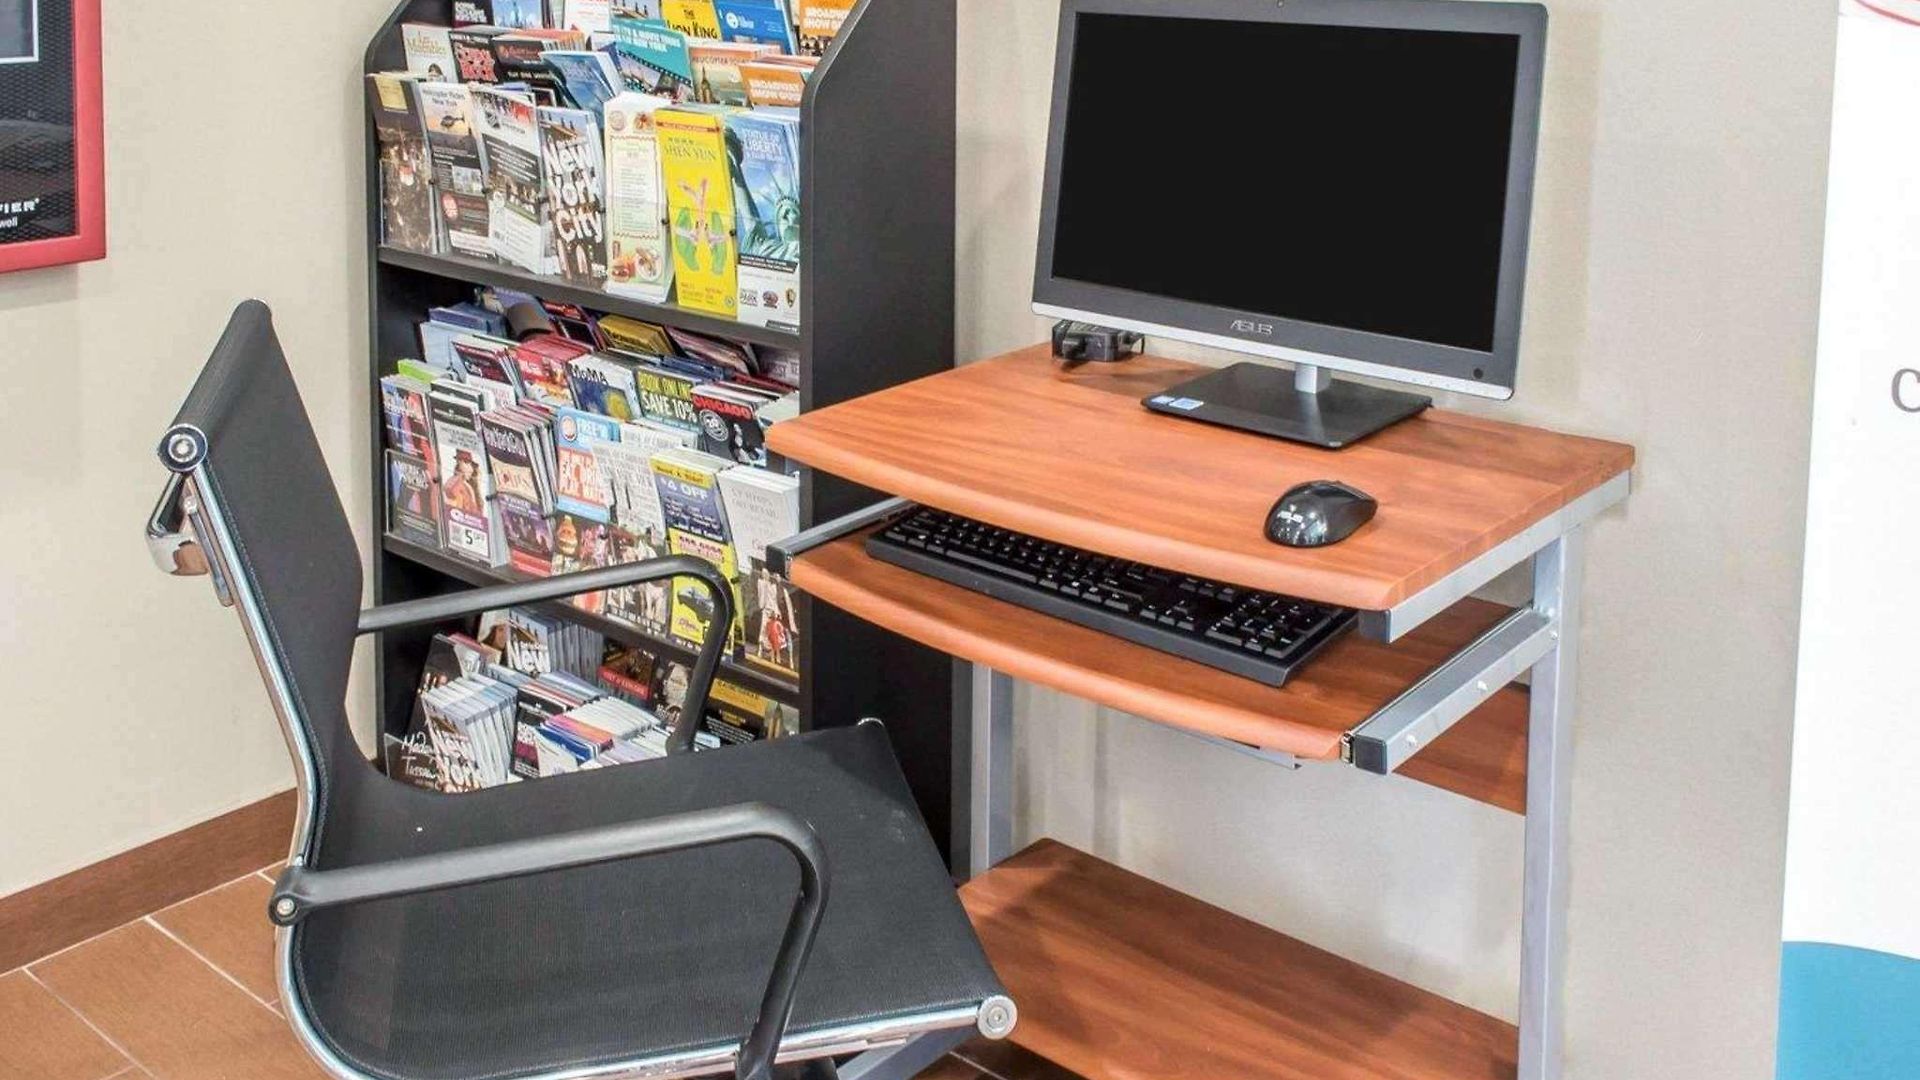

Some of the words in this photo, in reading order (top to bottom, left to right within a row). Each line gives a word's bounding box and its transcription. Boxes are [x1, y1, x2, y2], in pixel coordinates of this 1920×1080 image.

[691, 21, 718, 39] KING
[540, 137, 597, 179] New
[663, 145, 692, 158] SHEN
[692, 147, 717, 162] YUN
[546, 170, 600, 210] York
[0, 201, 35, 214] IER
[556, 207, 603, 244] City
[1230, 319, 1273, 335] ASUS
[570, 364, 609, 386] MoMA
[641, 391, 671, 416] SAVE
[672, 399, 699, 423] 10%
[692, 395, 753, 421] CHICAGO
